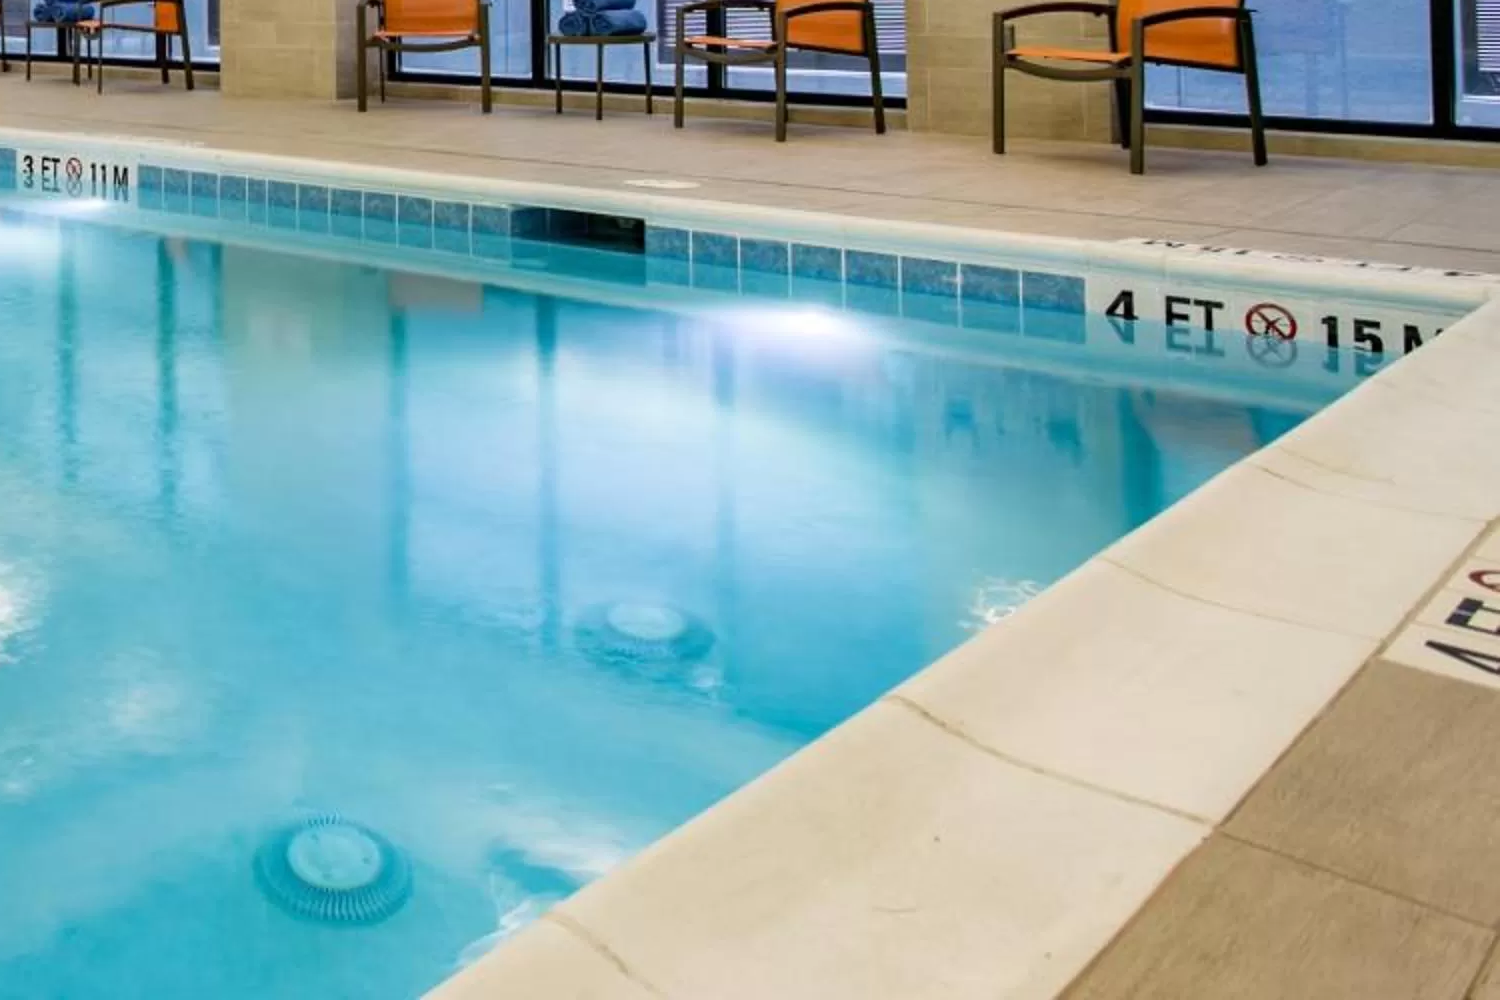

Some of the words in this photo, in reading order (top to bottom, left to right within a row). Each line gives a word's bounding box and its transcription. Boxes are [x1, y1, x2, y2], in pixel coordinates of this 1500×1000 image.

[22, 155, 34, 174] 3
[41, 156, 61, 178] FT
[1105, 290, 1138, 321] 4
[1165, 295, 1224, 332] FT
